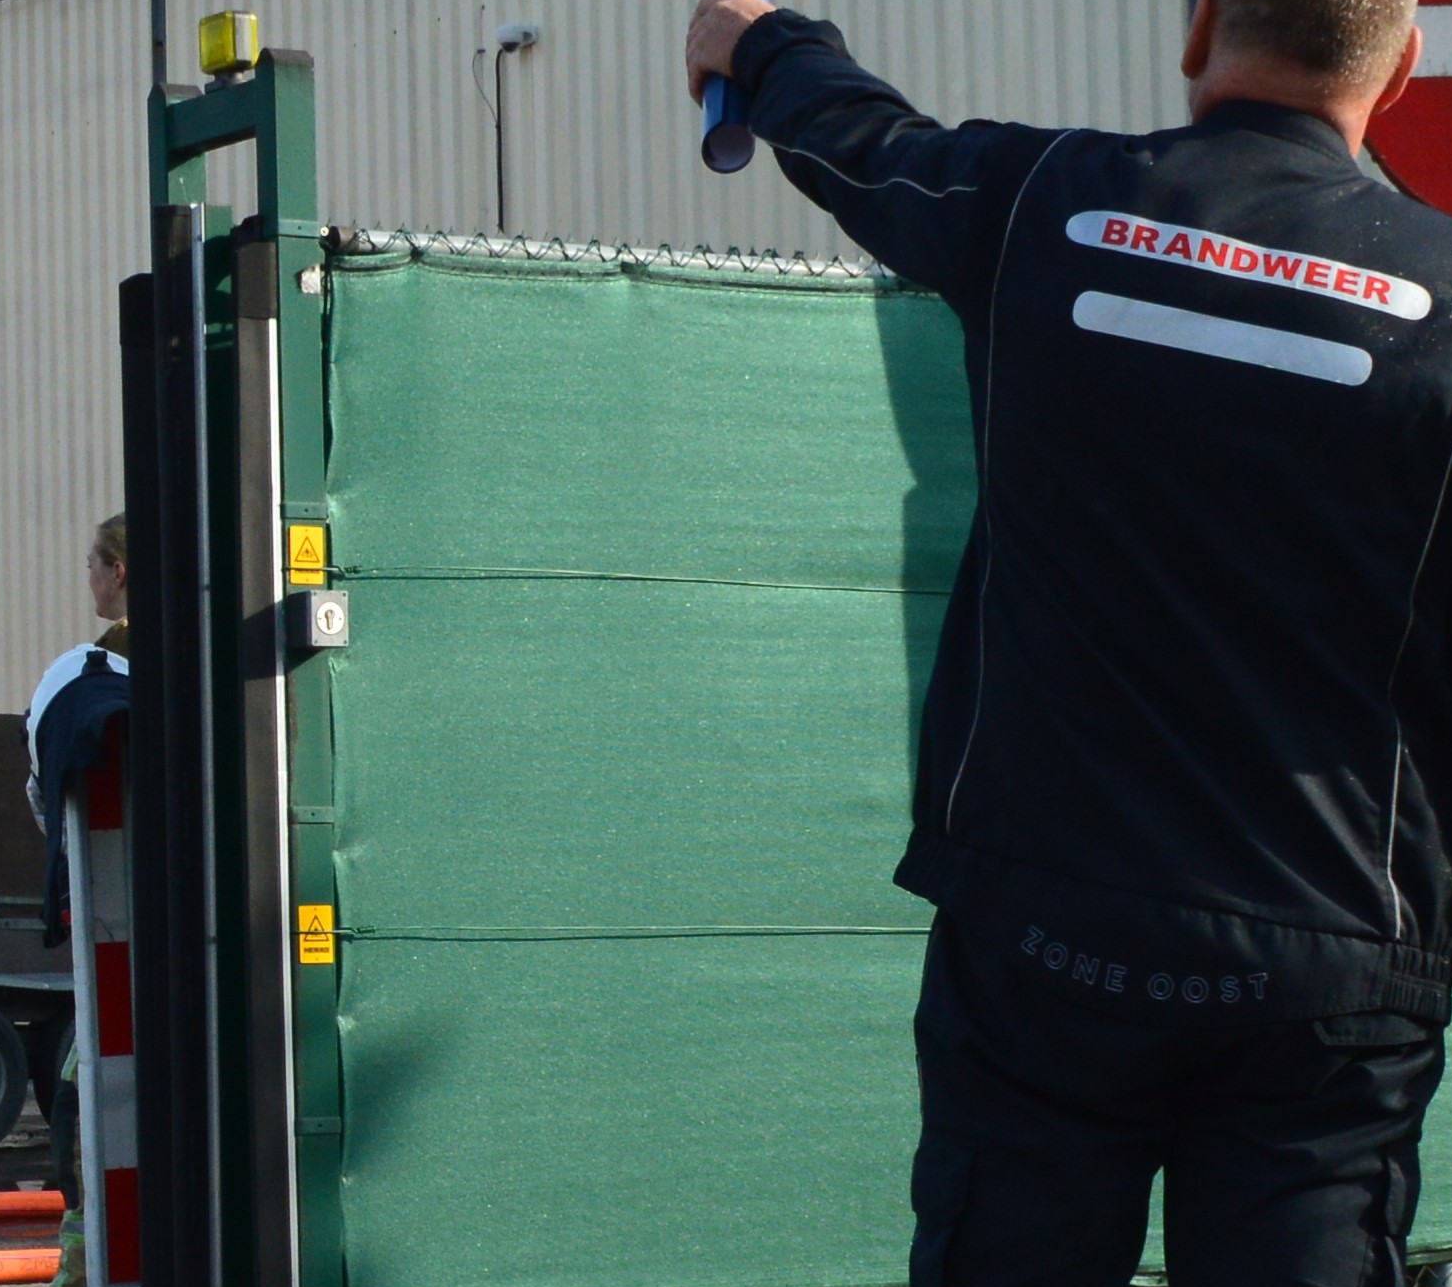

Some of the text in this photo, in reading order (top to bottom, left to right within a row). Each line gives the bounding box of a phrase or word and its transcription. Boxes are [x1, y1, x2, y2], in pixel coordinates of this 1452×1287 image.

[1100, 218, 1392, 306] BRANDWEER
[1020, 925, 1269, 1003] ZONE OOST
